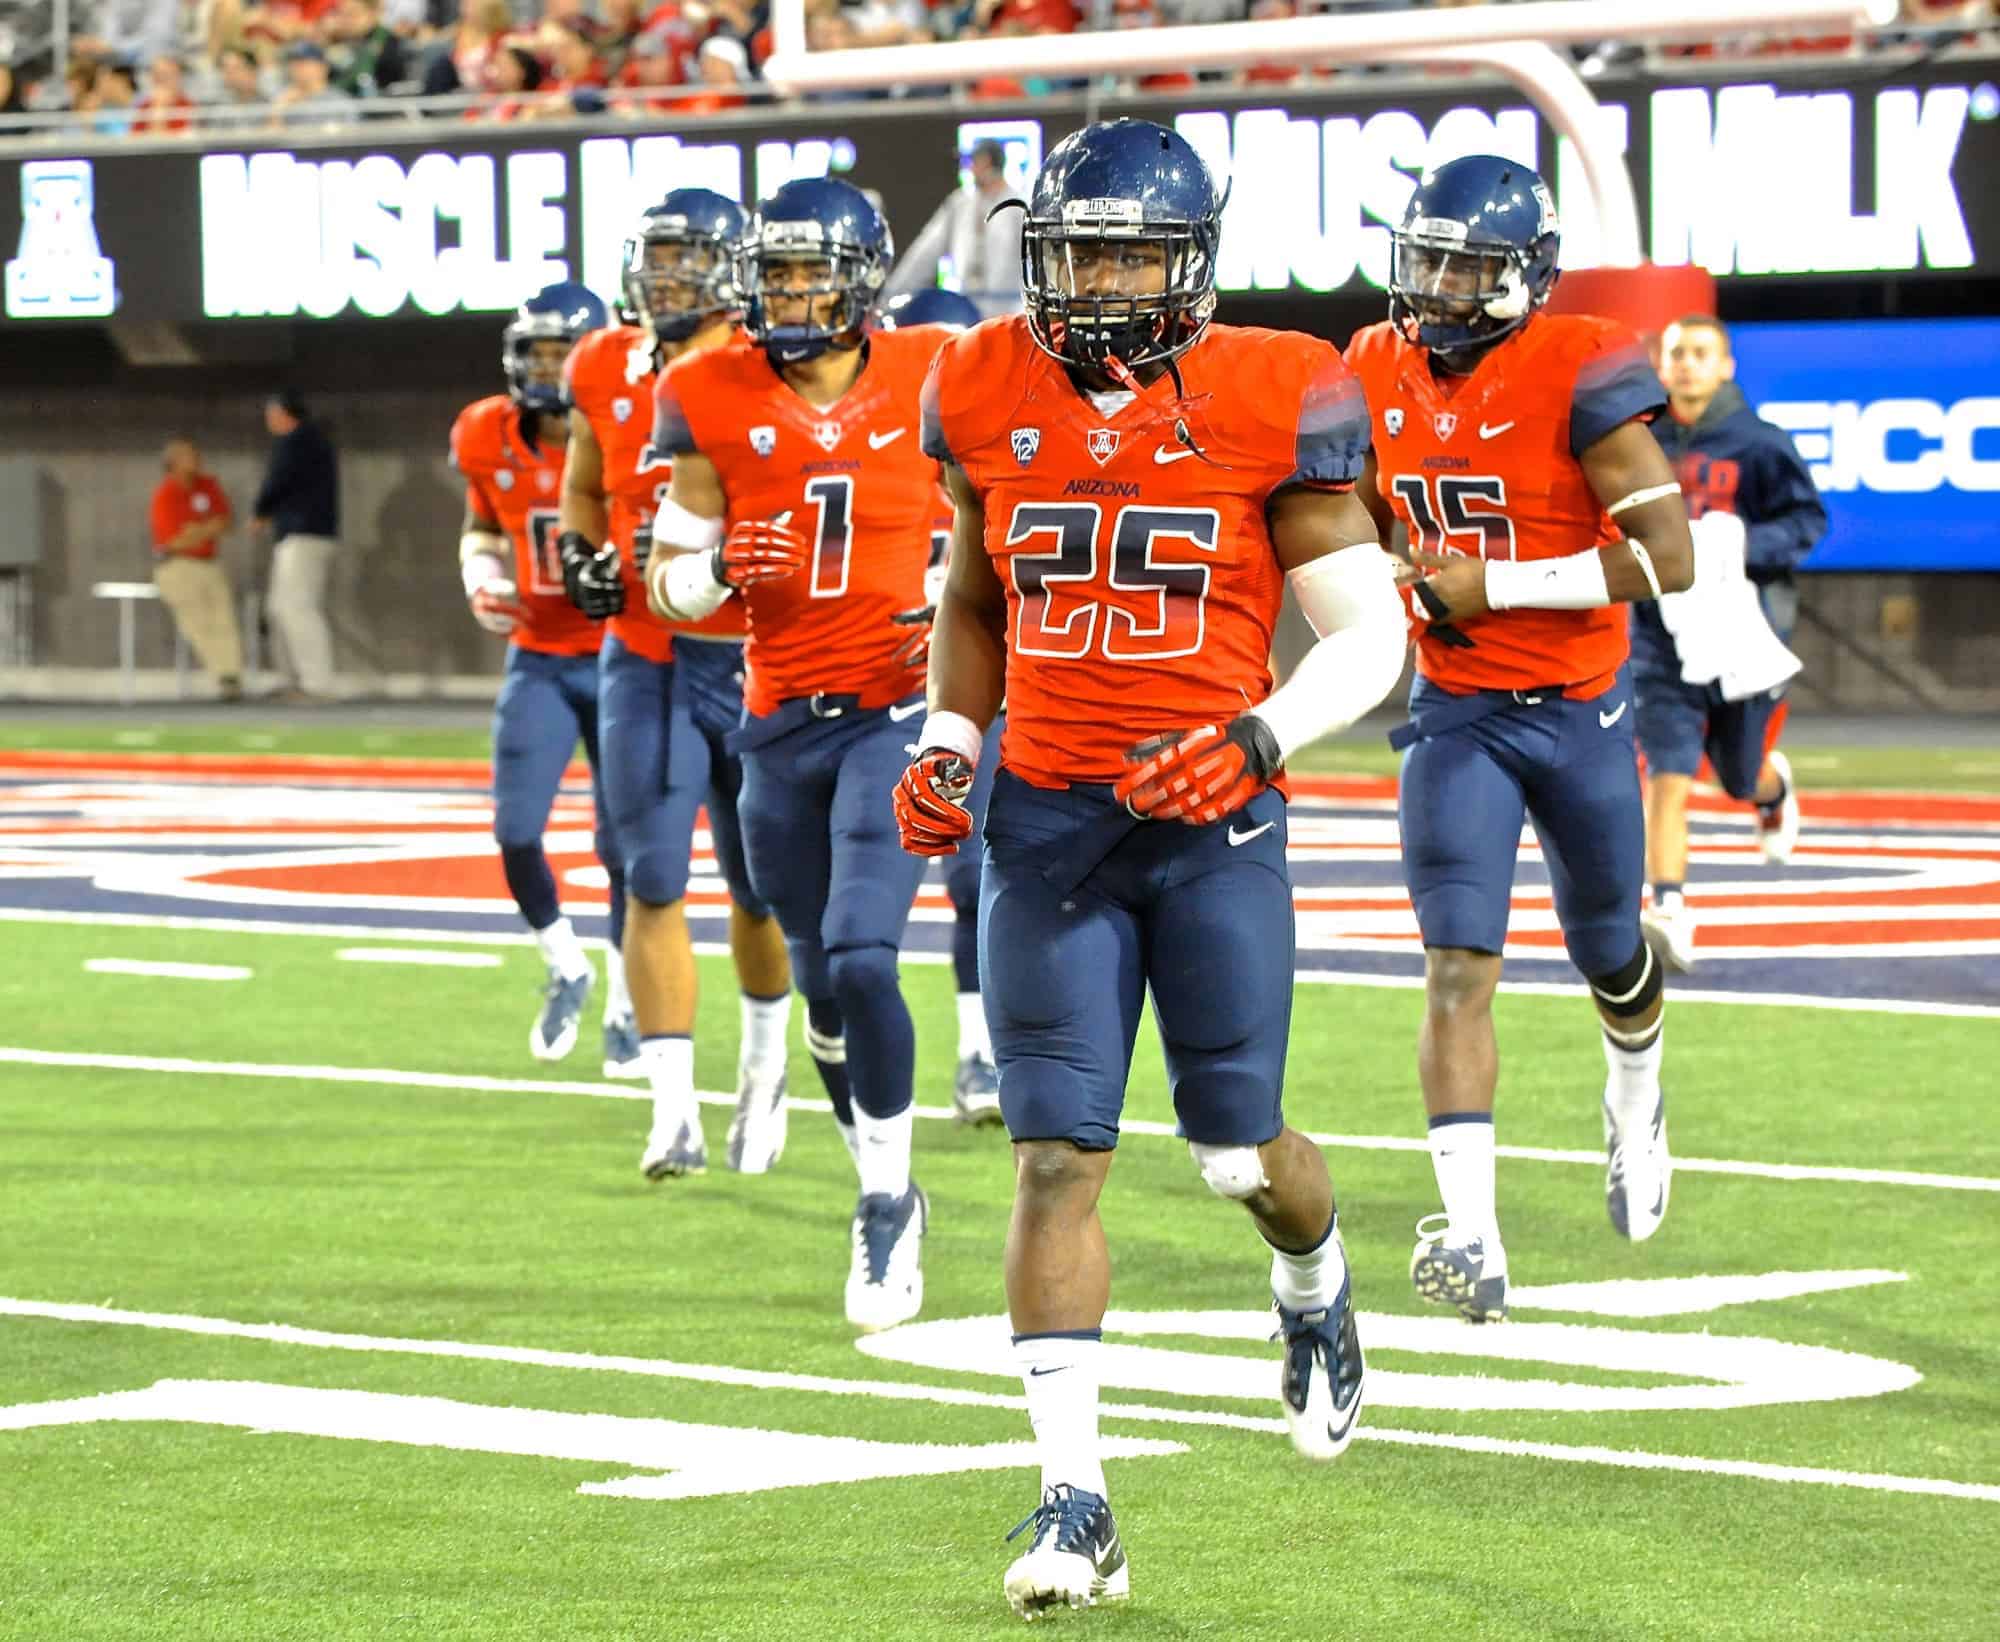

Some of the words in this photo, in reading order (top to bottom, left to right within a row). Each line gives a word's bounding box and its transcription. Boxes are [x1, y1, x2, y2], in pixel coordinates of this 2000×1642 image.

[200, 150, 569, 318] MUSCLE
[1177, 108, 1629, 291] MUS
[1650, 84, 1976, 276] MILK
[1062, 480, 1140, 497] ARIZONA
[1757, 397, 2000, 492] EICO
[804, 475, 855, 597] 1
[1005, 502, 1221, 660] 25
[1392, 474, 1517, 590] 15
